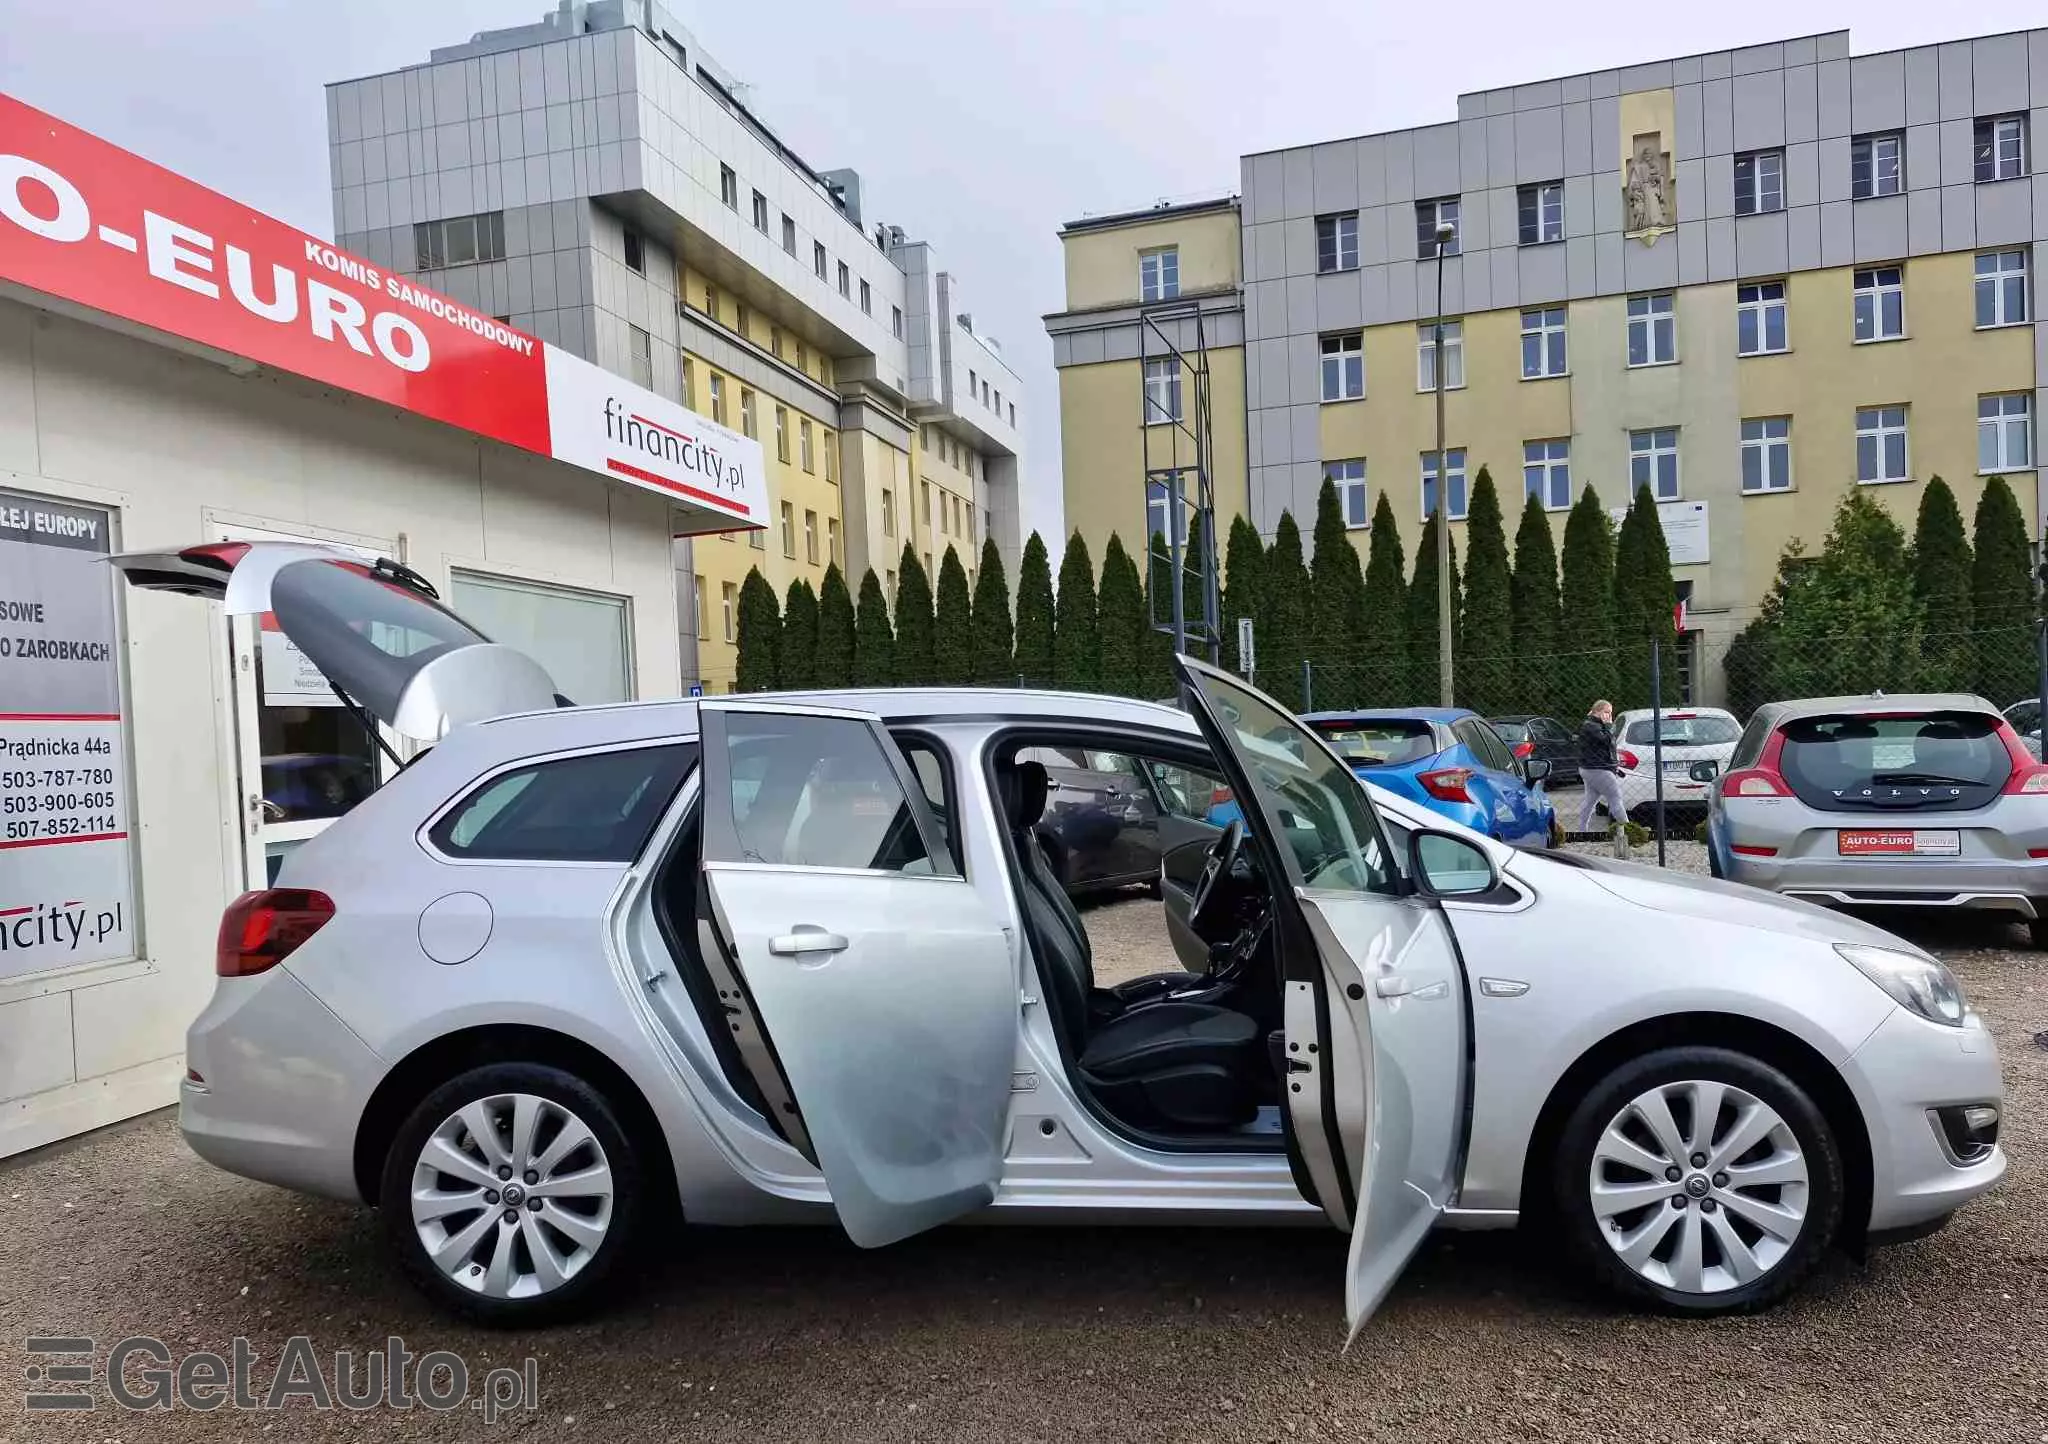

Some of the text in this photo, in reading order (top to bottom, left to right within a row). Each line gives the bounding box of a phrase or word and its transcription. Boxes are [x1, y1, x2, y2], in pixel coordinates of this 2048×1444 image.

[304, 239, 534, 357] KOMIS SAMOCHODOWY
[604, 397, 745, 492] financity.pl
[34, 511, 97, 539] EUROPY
[16, 638, 110, 661] ZAROBKACH
[0, 737, 111, 761] Prądnicka 44a
[2, 768, 113, 789] 503-787-780
[4, 792, 114, 814] 503-900-605
[1832, 789, 1960, 797] VOLVO
[7, 815, 115, 839] 507-852-114
[1847, 837, 1913, 845] AUTO-EURO
